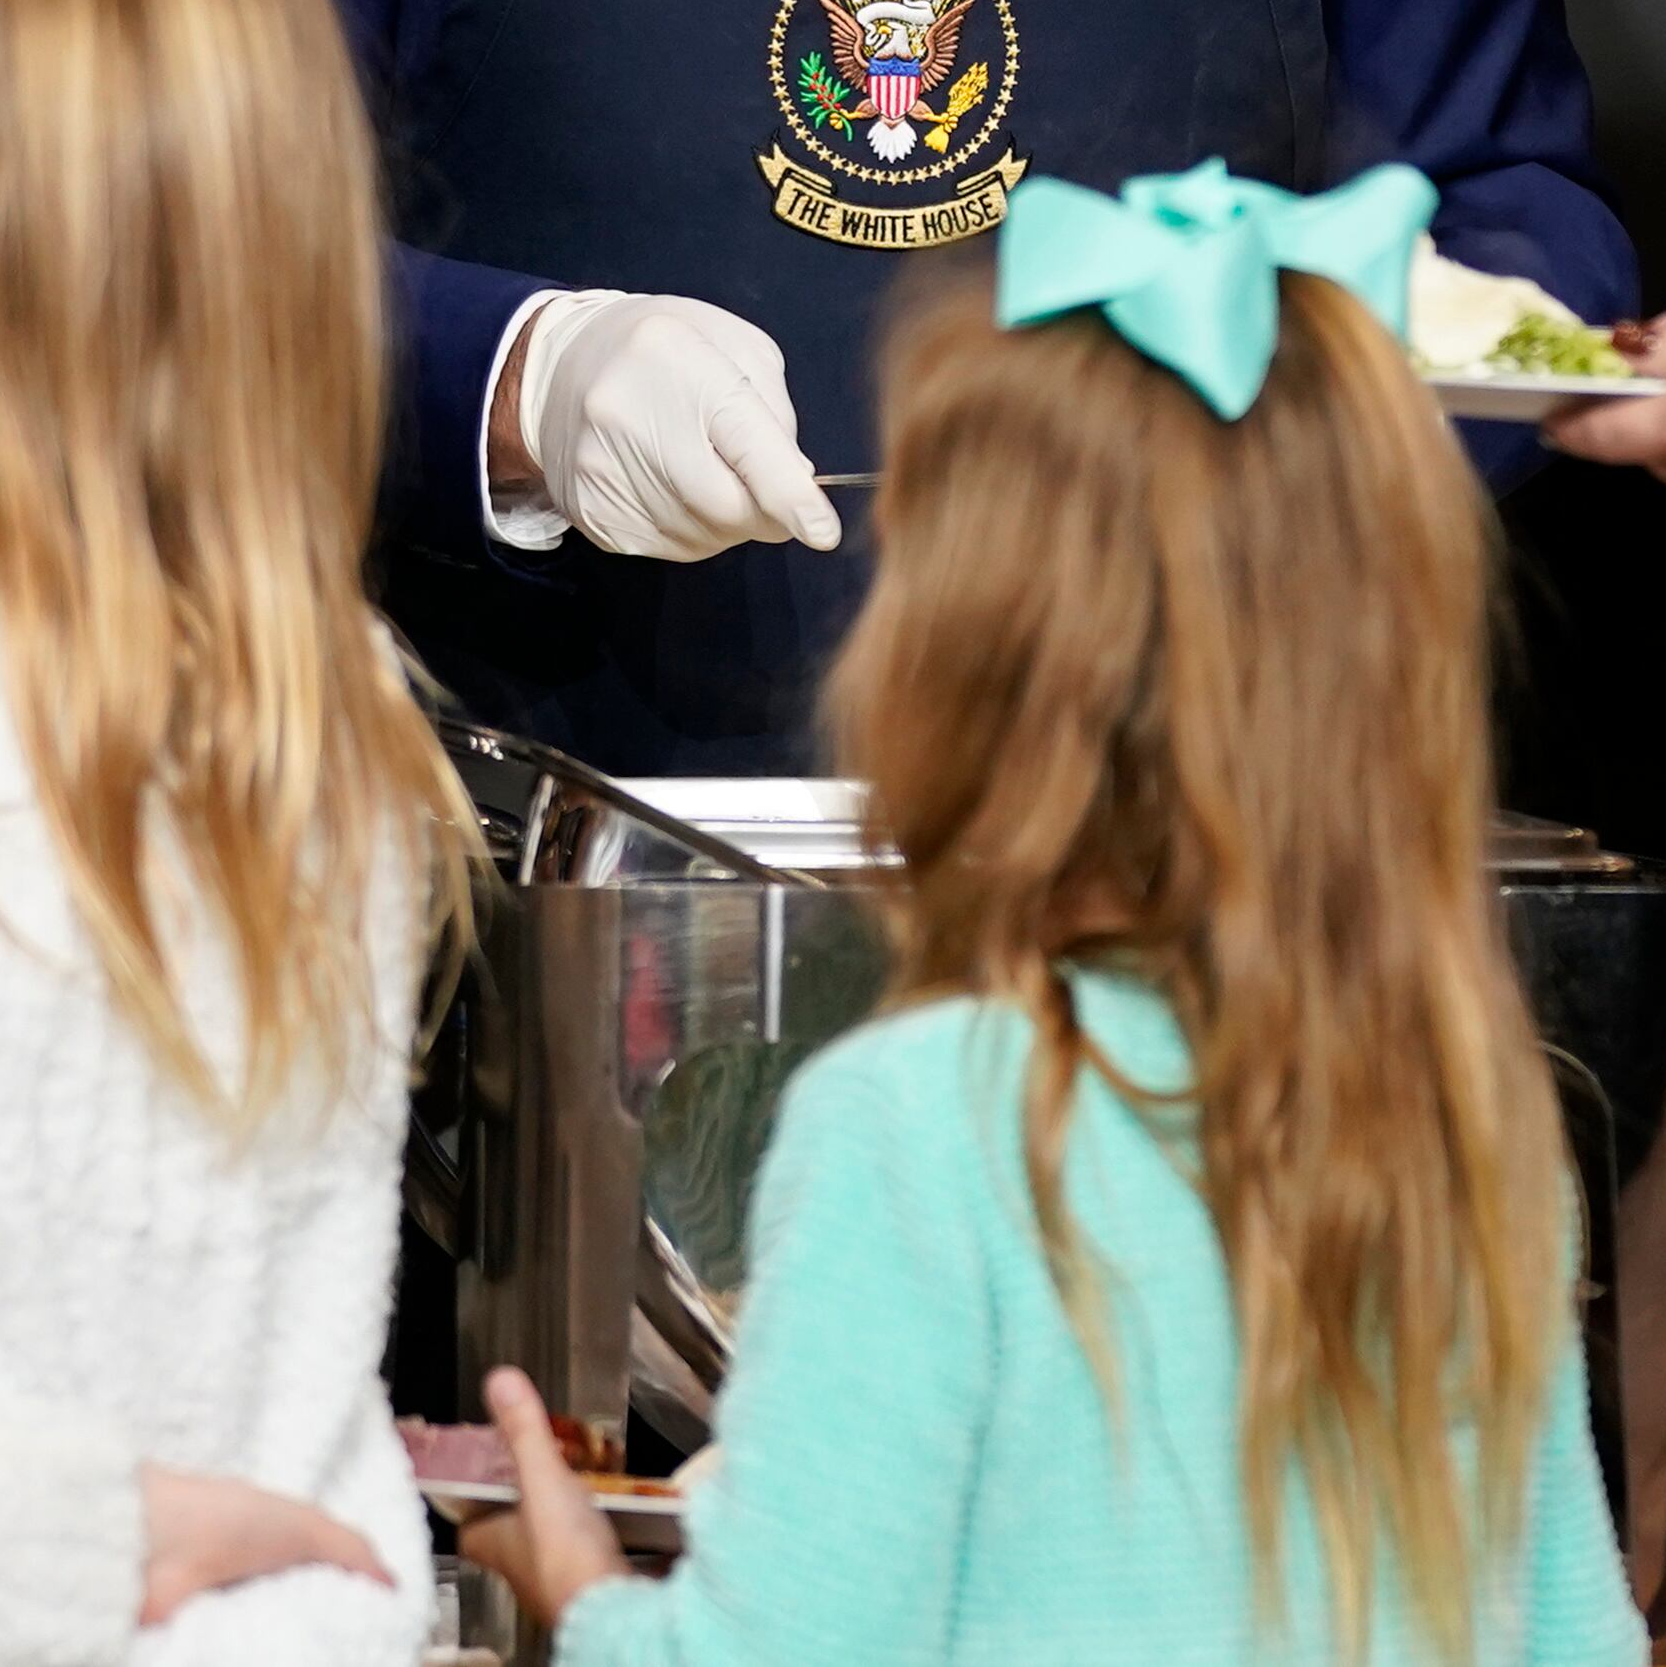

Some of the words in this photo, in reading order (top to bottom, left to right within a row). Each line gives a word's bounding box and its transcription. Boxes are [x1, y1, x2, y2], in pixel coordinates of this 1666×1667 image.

[786, 188, 836, 231] THE
[840, 209, 915, 243] WHITE
[921, 191, 1000, 240] HOUSE
